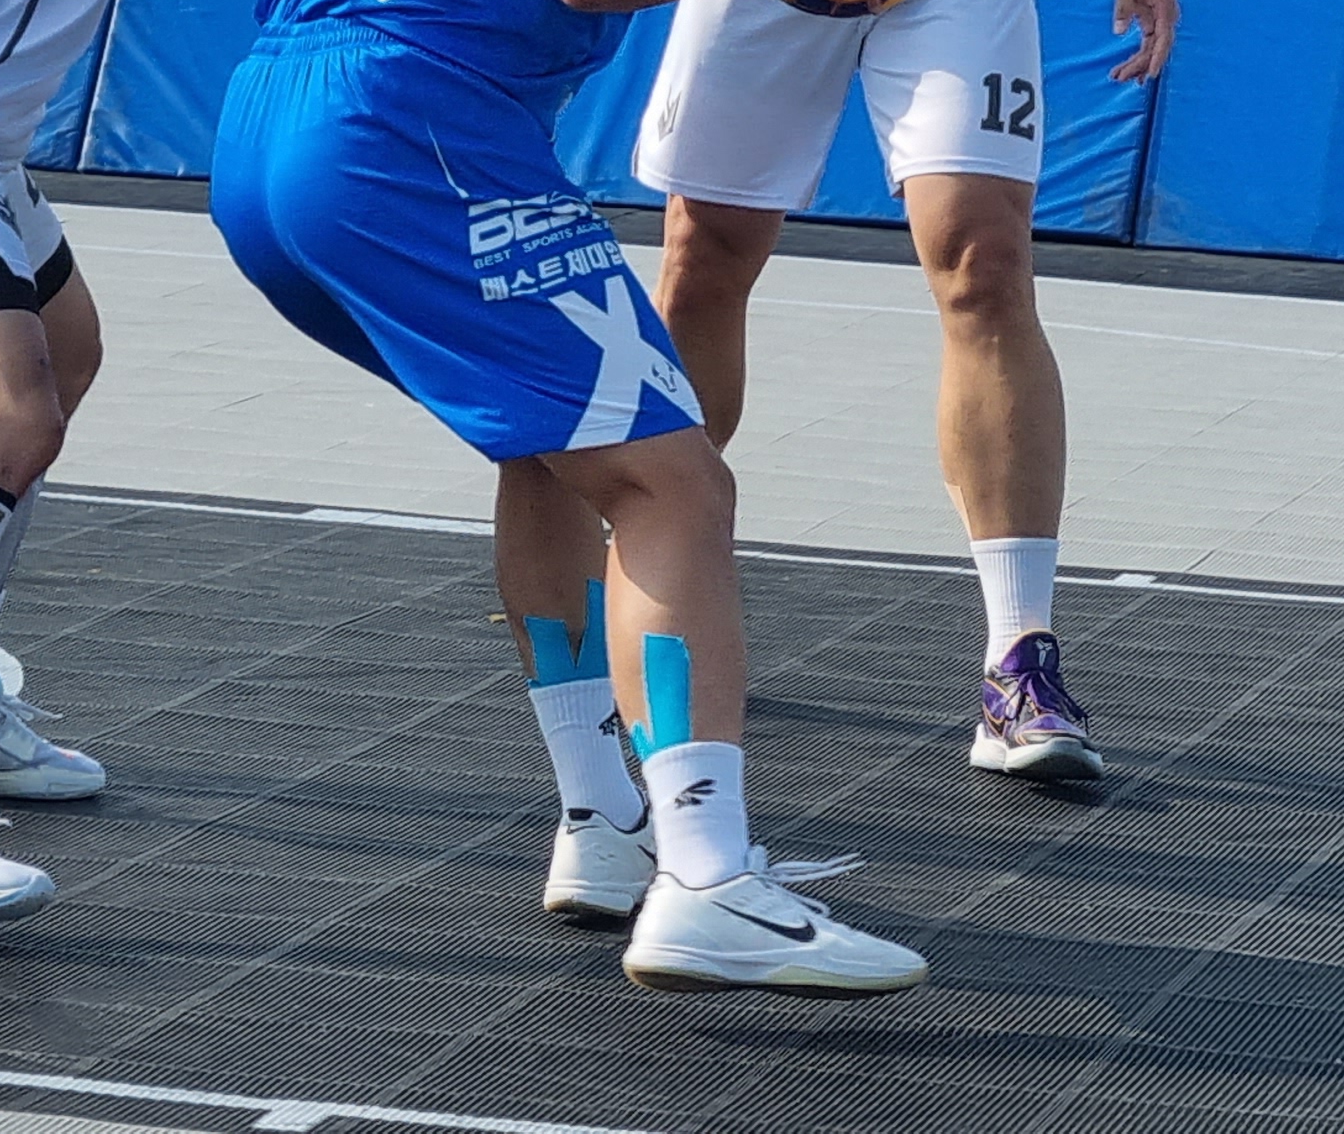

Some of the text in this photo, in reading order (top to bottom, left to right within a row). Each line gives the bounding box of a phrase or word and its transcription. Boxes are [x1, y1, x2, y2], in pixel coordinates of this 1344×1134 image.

[980, 72, 1035, 142] 12
[473, 248, 512, 270] BEST
[523, 227, 574, 253] SPORTS
